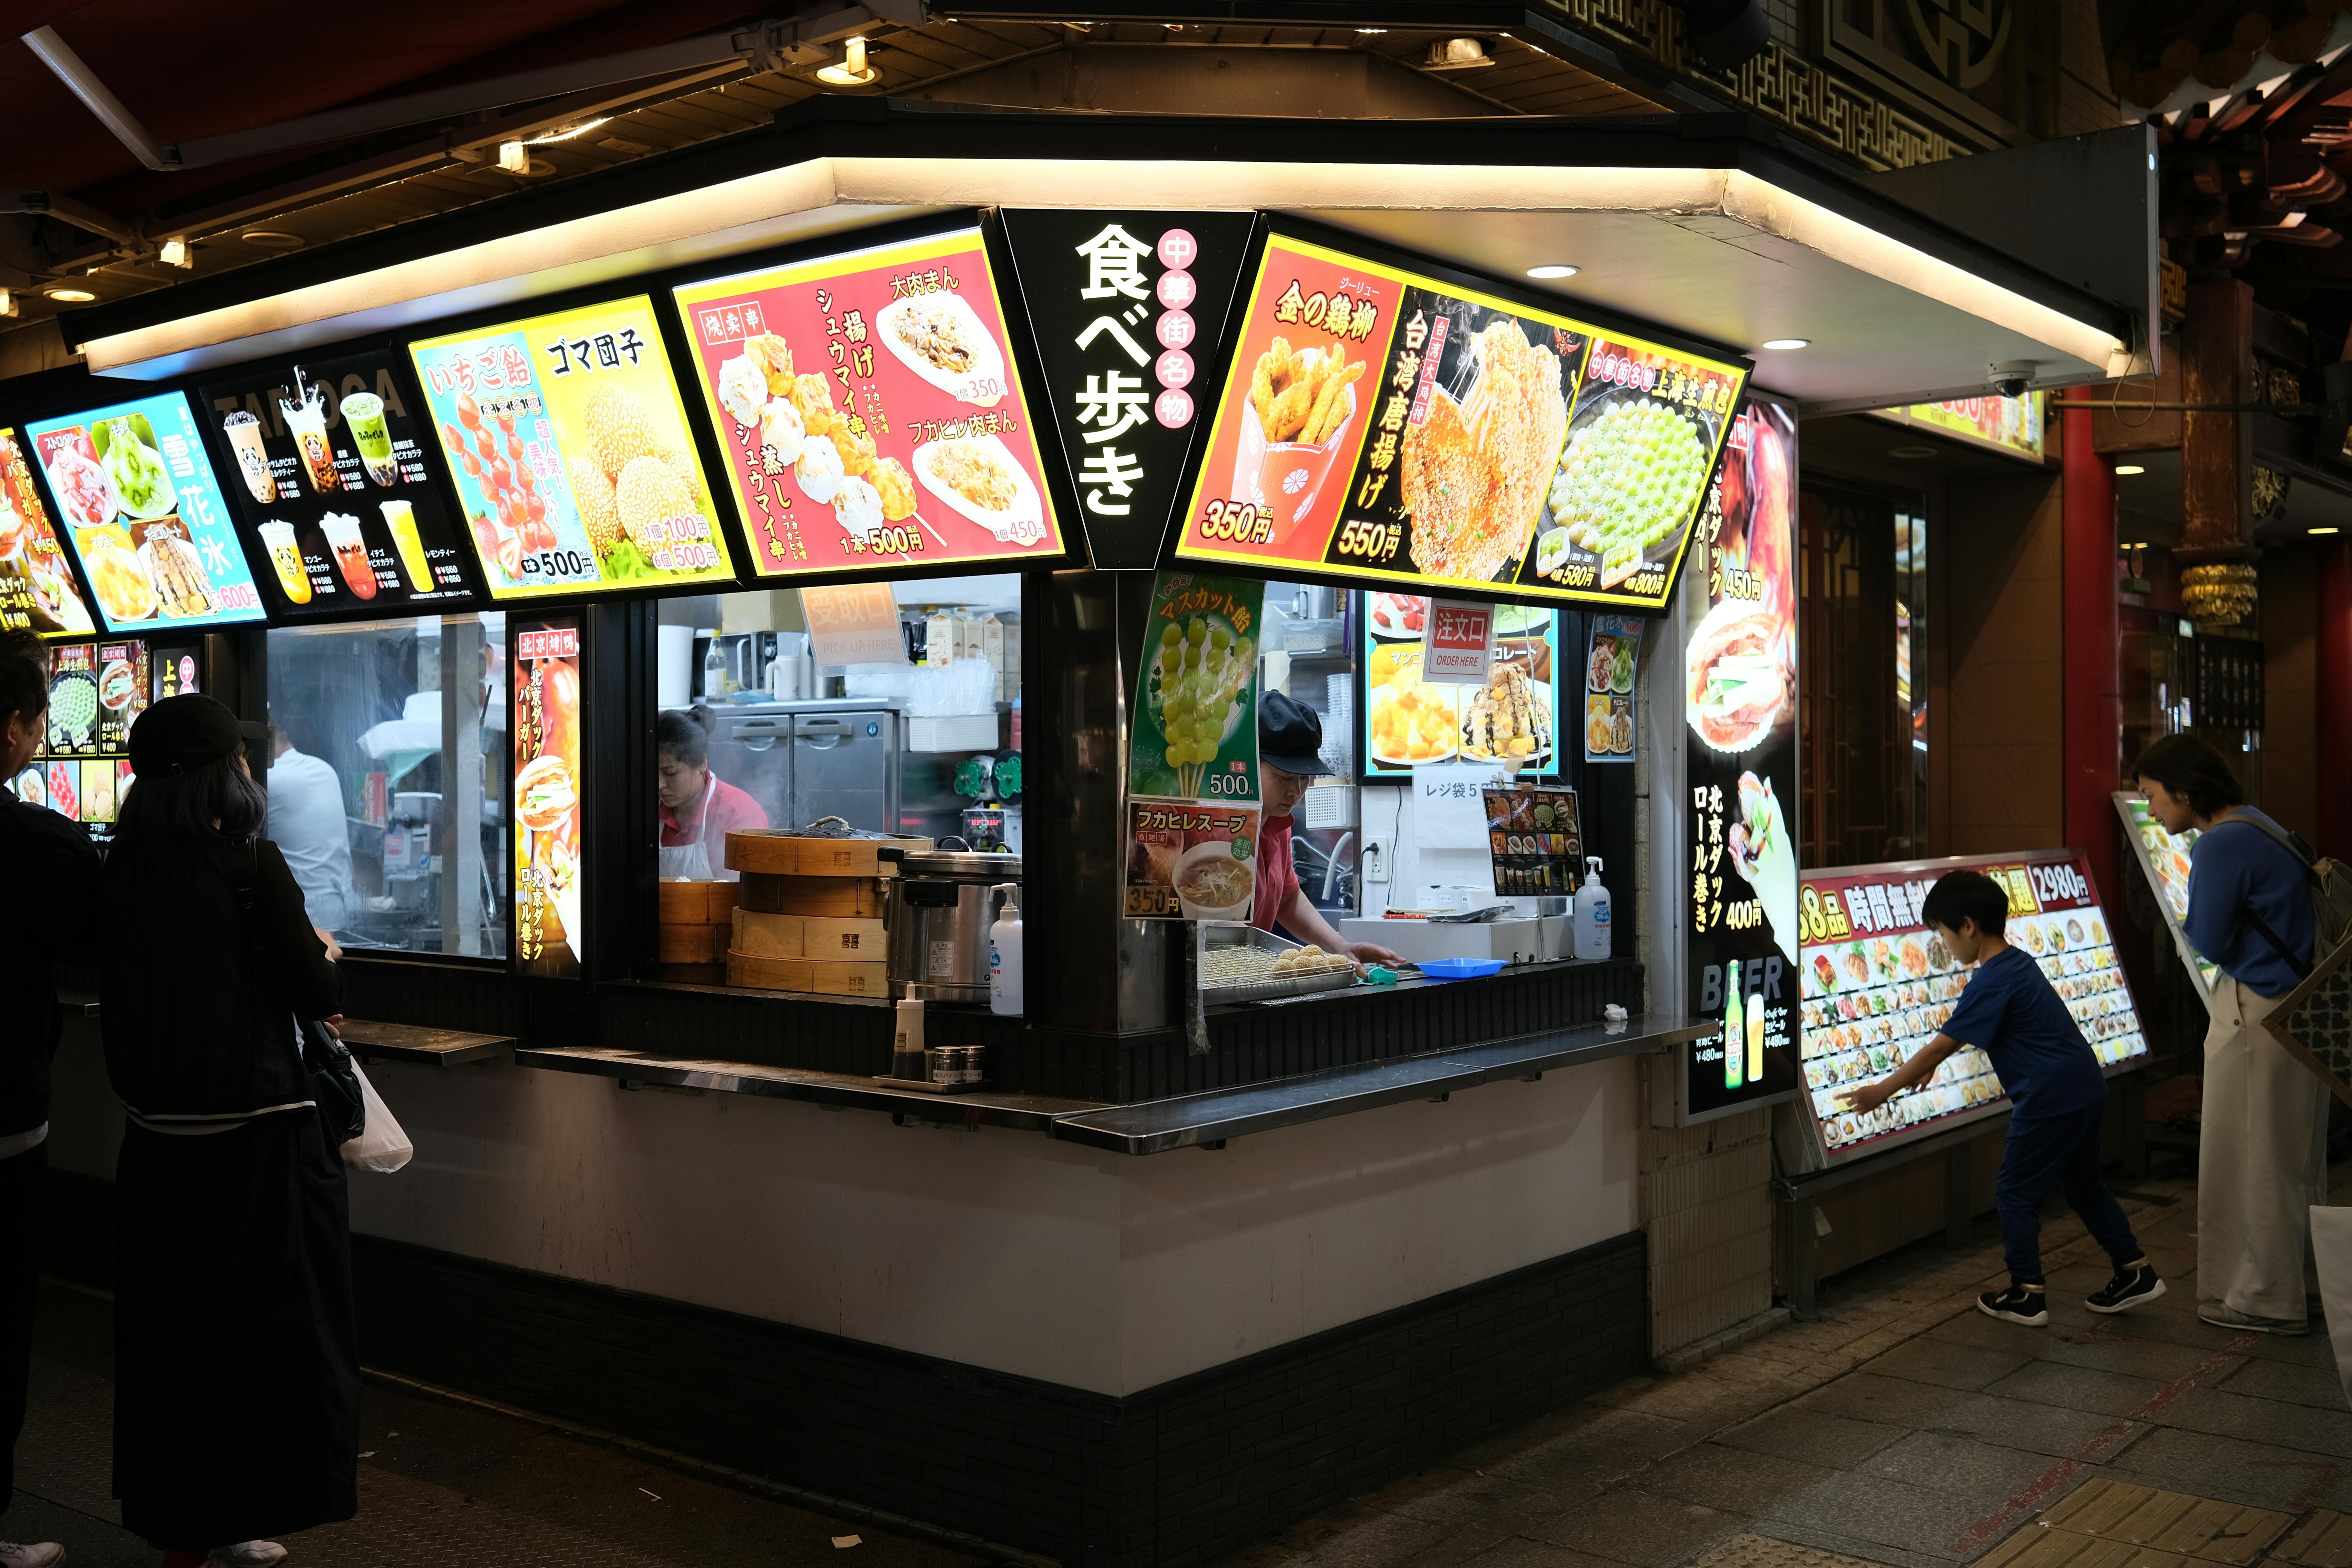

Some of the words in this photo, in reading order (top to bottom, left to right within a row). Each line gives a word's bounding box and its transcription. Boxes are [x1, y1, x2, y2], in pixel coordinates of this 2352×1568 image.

[889, 266, 959, 300] 大肉まん
[1339, 277, 1380, 297] ジーリュー
[1160, 234, 1192, 423] 中華街名物
[1274, 279, 1378, 344] 金の鶏柳
[546, 328, 644, 374] ゴマ団子
[816, 289, 867, 440] シュウマイ串
[427, 348, 531, 394] いちご飴
[1074, 224, 1153, 516] 食べ歩き
[1591, 353, 1655, 390] 中華街名物
[213, 368, 406, 439] TAPOCA
[483, 396, 540, 416] 北京名物
[1357, 308, 1429, 510] 台湾唐揚げ
[1651, 367, 1731, 415] 上海生煎包
[44, 431, 81, 450] ストロベリー
[110, 421, 130, 437] キウイ
[908, 410, 1018, 444] フカヒレ肉まん
[7, 459, 40, 536] バーガー
[8, 439, 50, 534] 北京ダック
[161, 433, 233, 576] 雪花氷
[735, 423, 786, 562] シュウマイ串
[144, 524, 183, 542] チョコレート
[1200, 498, 1273, 544] 350円
[32, 536, 60, 556] ¥450
[425, 549, 456, 559] レモンティー
[1338, 520, 1400, 559] 550円
[1164, 575, 1188, 596] 新商品
[1725, 568, 1761, 601] 450円
[5, 612, 31, 628] ¥400
[810, 590, 889, 626] 受取口
[1159, 586, 1251, 634] マスカット飴
[522, 633, 574, 654] 北京烤鴨
[1436, 612, 1485, 643] 注文口
[823, 642, 847, 655] PICK
[850, 640, 864, 652] UP
[868, 639, 894, 652] HERE
[1436, 655, 1459, 666] ORDER
[1460, 656, 1479, 667] HERE
[1492, 645, 1538, 660] コレート
[518, 684, 530, 761] バーガー
[530, 667, 543, 759] 北京ダック
[1210, 773, 1254, 796] 500円
[1231, 762, 1245, 772] 1本
[1137, 810, 1246, 834] フカヒレスープ
[1138, 833, 1166, 842] 魚翅湯
[1233, 847, 1249, 860] 効果
[1235, 838, 1251, 850] 美肌
[1692, 786, 1708, 933] ロール巻き
[1707, 784, 1724, 928] 北京ダック
[520, 867, 533, 960] ロール巻き
[531, 869, 544, 960] 北京ダック
[1725, 900, 1762, 930] 400円
[1843, 879, 1938, 933] 時間無制
[2032, 864, 2089, 902] 2980円
